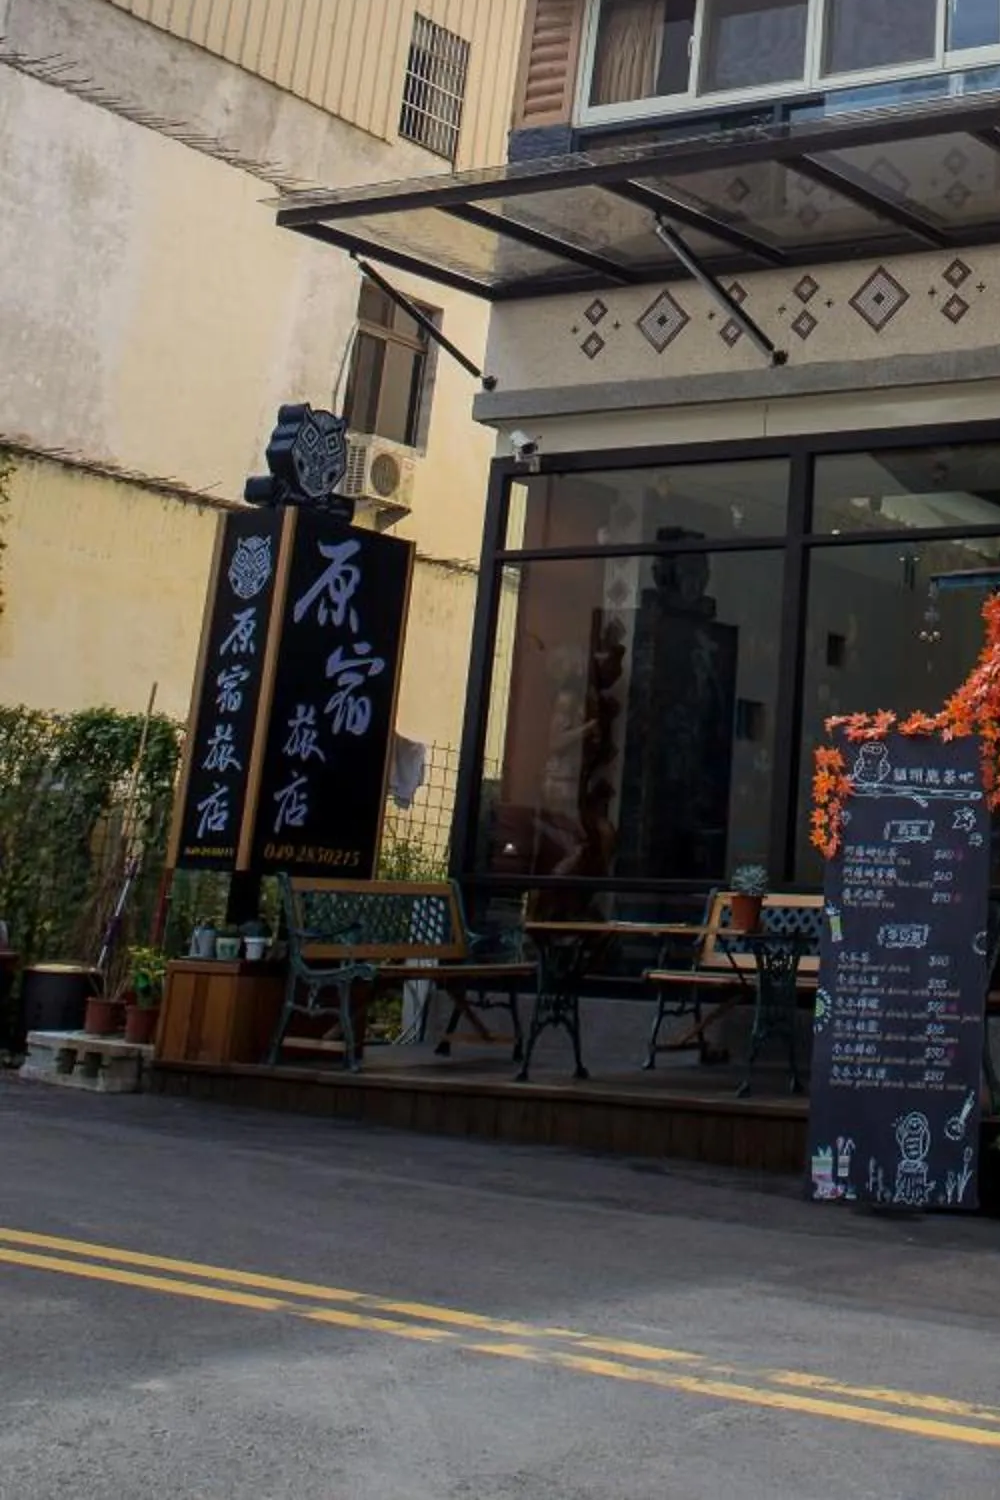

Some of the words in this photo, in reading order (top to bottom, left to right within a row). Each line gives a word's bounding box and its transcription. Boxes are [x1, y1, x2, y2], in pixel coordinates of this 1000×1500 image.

[196, 607, 257, 839] 原宿旅店
[293, 538, 386, 737] 原宿
